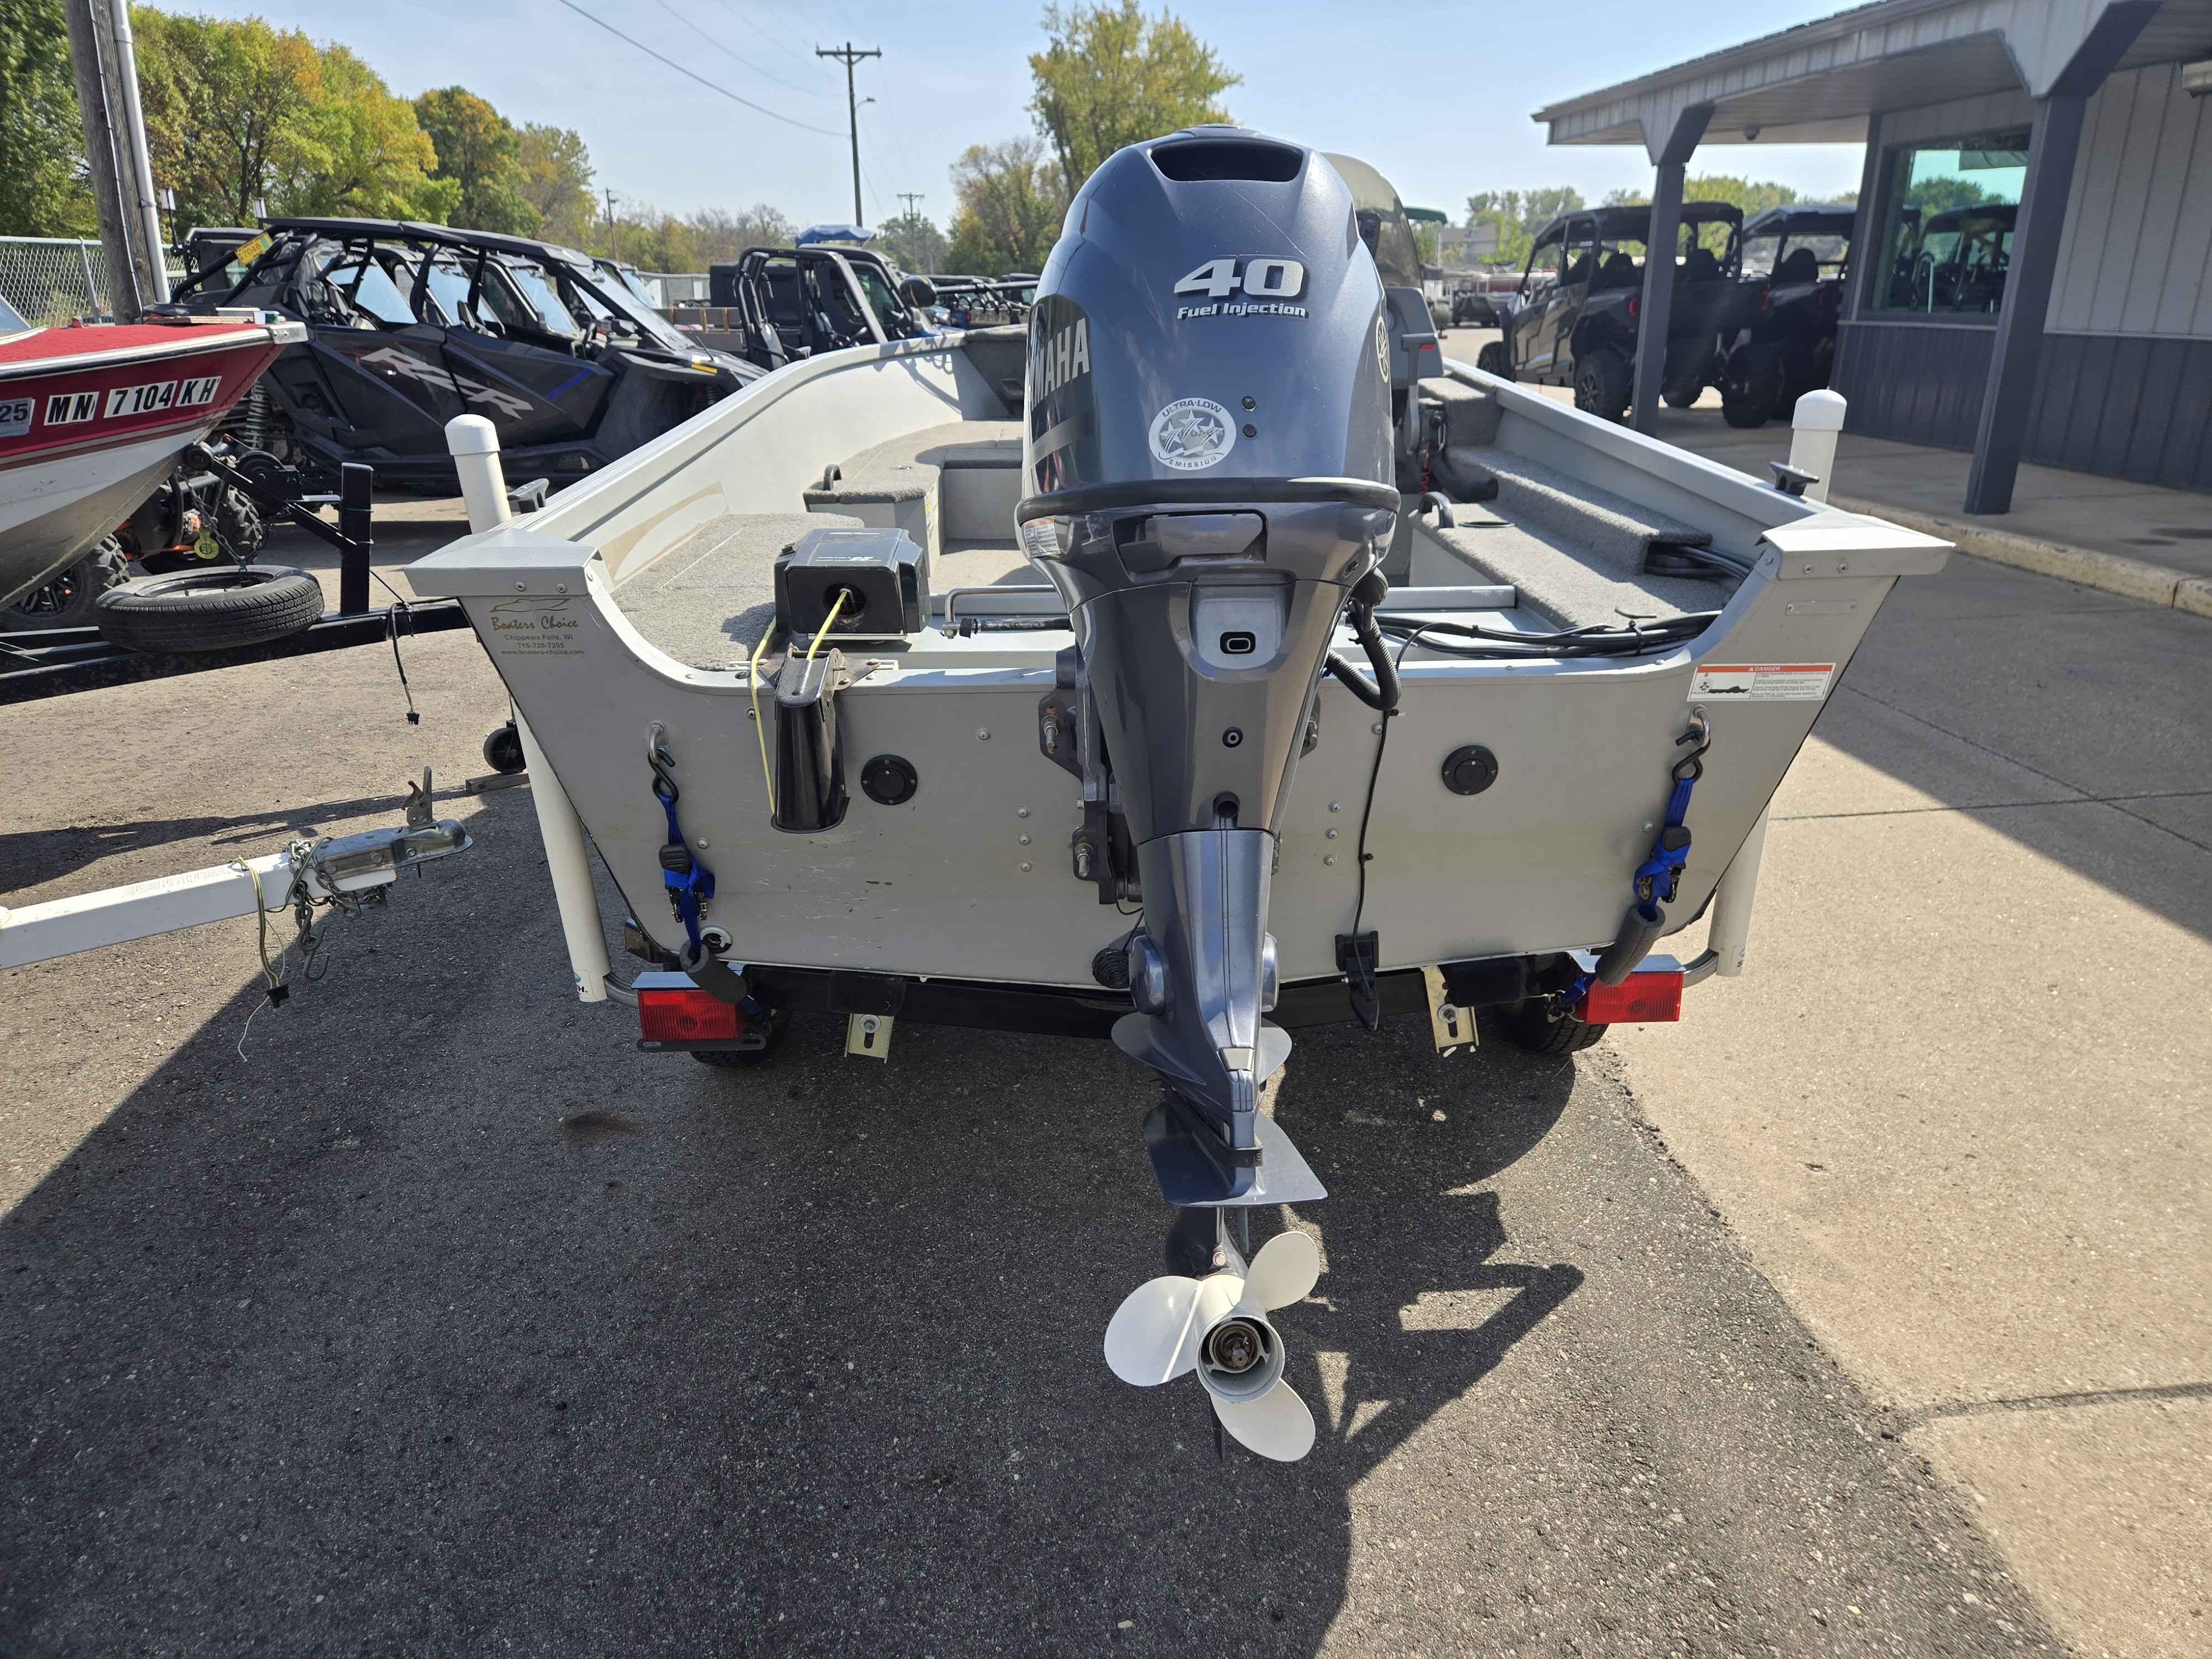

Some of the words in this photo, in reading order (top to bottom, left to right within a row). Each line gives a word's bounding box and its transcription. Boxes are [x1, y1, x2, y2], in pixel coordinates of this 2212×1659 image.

[1173, 259, 1304, 297] 40
[1177, 303, 1218, 319] Fuel
[1222, 302, 1306, 316] Injection
[0, 403, 28, 423] 25
[48, 394, 93, 423] MN
[112, 385, 172, 415] 7104
[1169, 455, 1217, 468] EMISSION
[490, 617, 535, 631] Boaters
[541, 615, 578, 629] Choice
